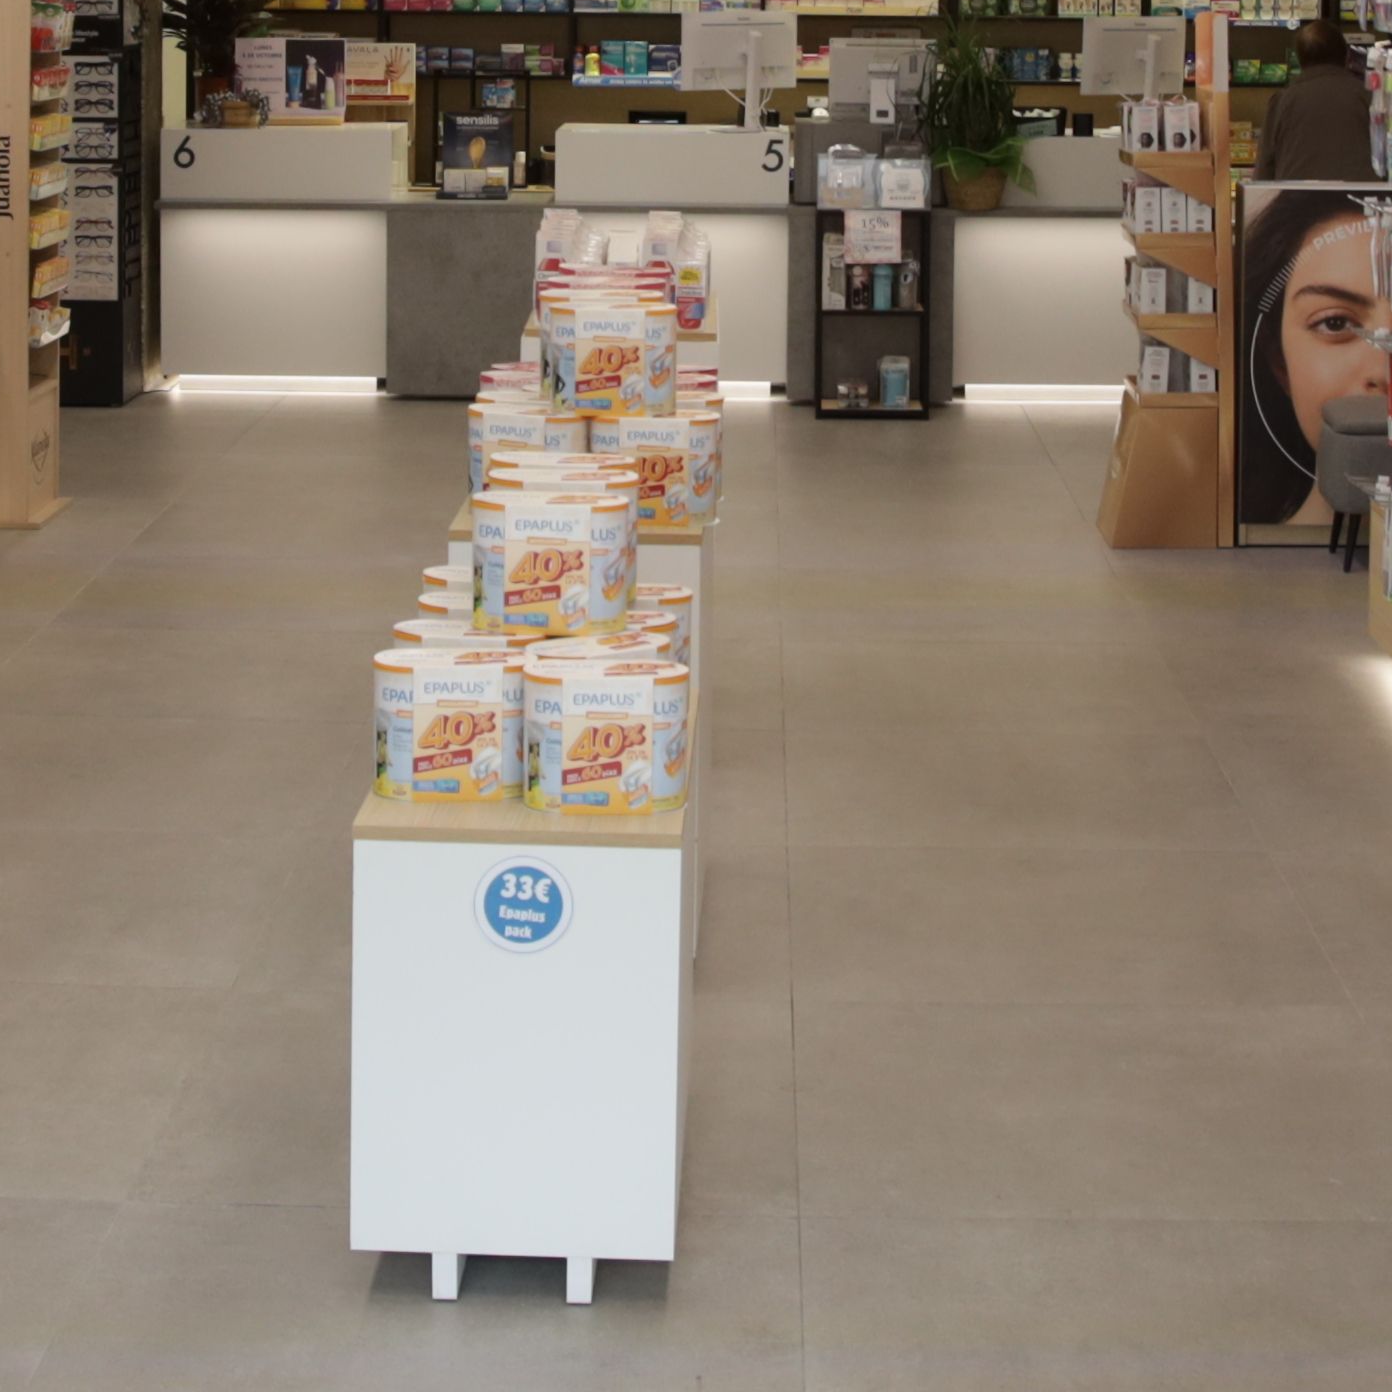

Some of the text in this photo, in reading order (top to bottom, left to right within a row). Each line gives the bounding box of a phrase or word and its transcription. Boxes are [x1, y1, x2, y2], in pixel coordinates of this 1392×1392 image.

[455, 115, 499, 125] sensilis
[173, 135, 196, 169] 6
[762, 140, 784, 172] 5
[583, 321, 631, 332] EPAPLUS
[490, 425, 533, 437] EPAPLUS
[627, 430, 675, 443] EPAPLUS
[515, 519, 574, 533] EPAPLUS
[509, 548, 584, 585] 40%
[424, 681, 485, 694] EPAPLUS
[573, 693, 635, 706] EPAPLUS
[418, 711, 496, 749] 40%
[567, 723, 647, 761] 40%
[433, 754, 452, 768] 60
[582, 767, 602, 780] 60
[500, 873, 552, 903] 33€
[499, 906, 546, 923] Epaplus
[504, 924, 533, 939] pack
